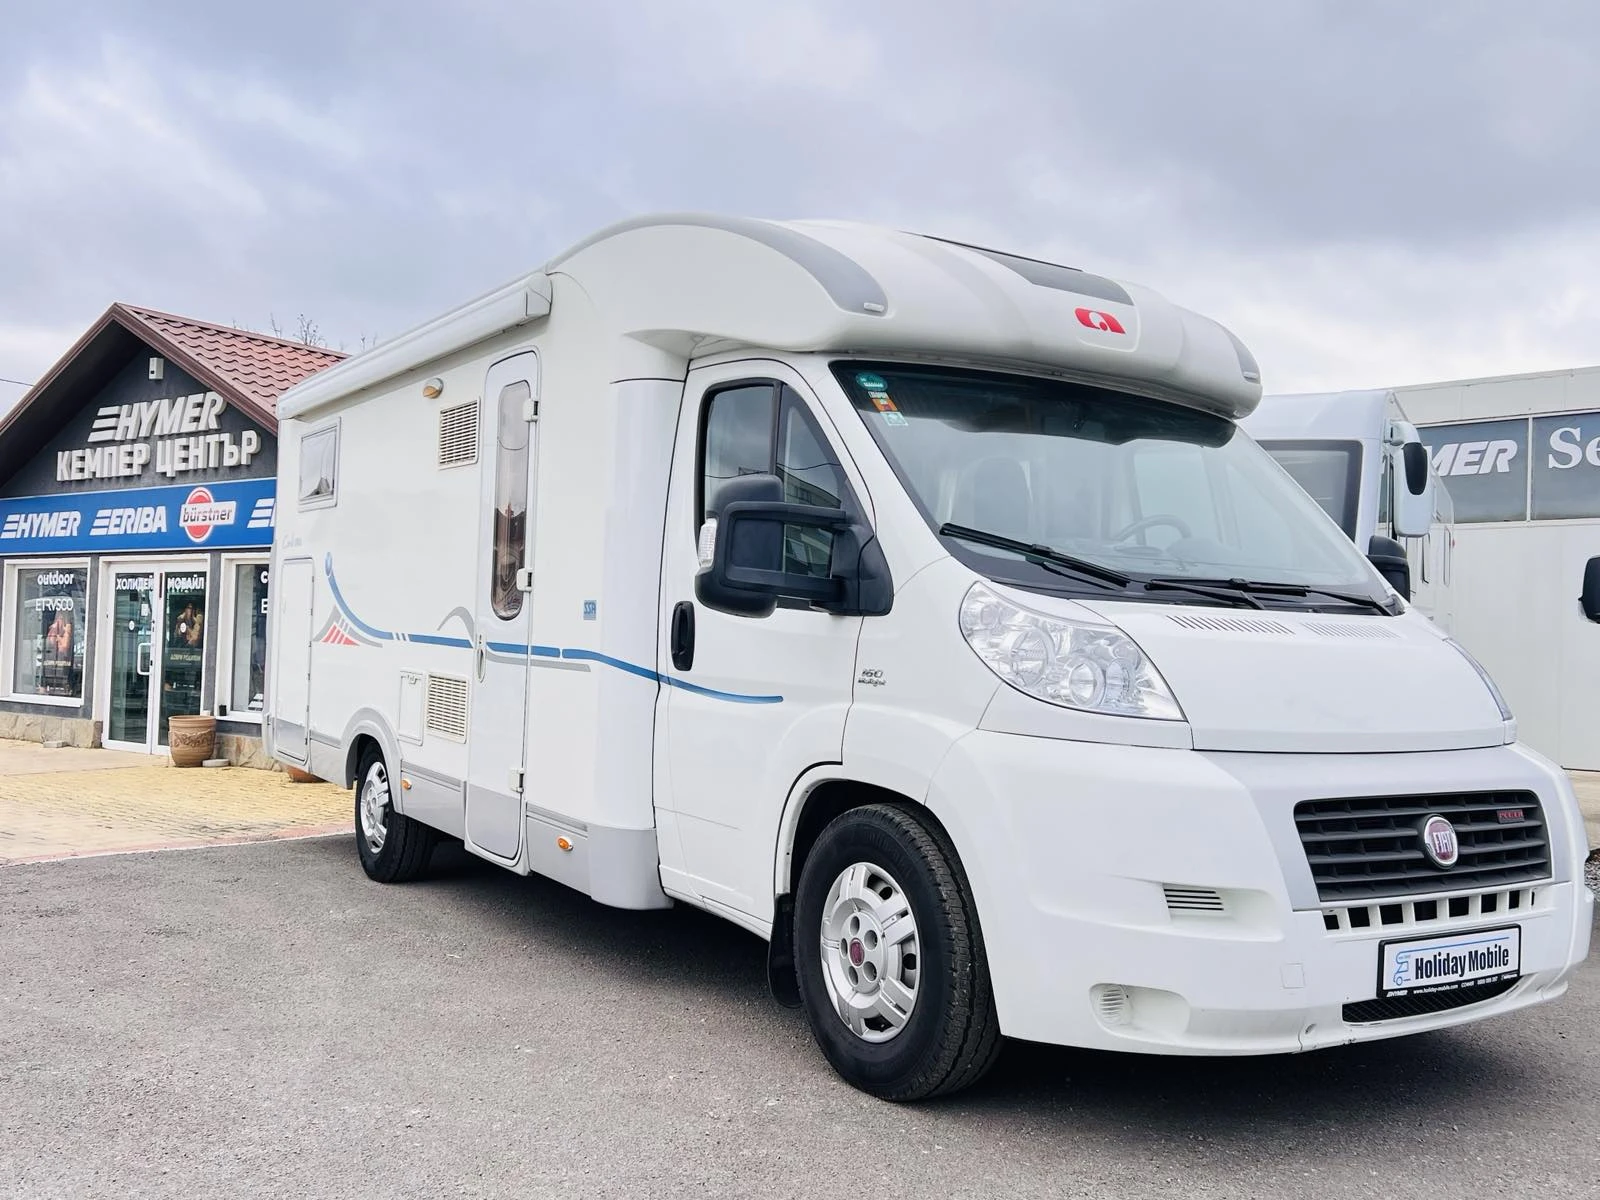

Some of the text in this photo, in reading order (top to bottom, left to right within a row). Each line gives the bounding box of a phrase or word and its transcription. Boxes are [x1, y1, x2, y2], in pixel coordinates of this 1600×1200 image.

[112, 391, 226, 441] HYMER
[56, 430, 261, 482] КЕМПЕР ЦЕНТЪР
[13, 510, 82, 539] HYMER
[103, 505, 168, 535] ERIBA
[182, 506, 233, 523] bürstner
[37, 571, 74, 585] outdoor
[116, 575, 154, 591] ХОЛИДЕЙ
[167, 574, 205, 590] МОБАЙЛ
[1432, 830, 1453, 854] FIAT
[1415, 943, 1509, 980] Holiday Mobile
